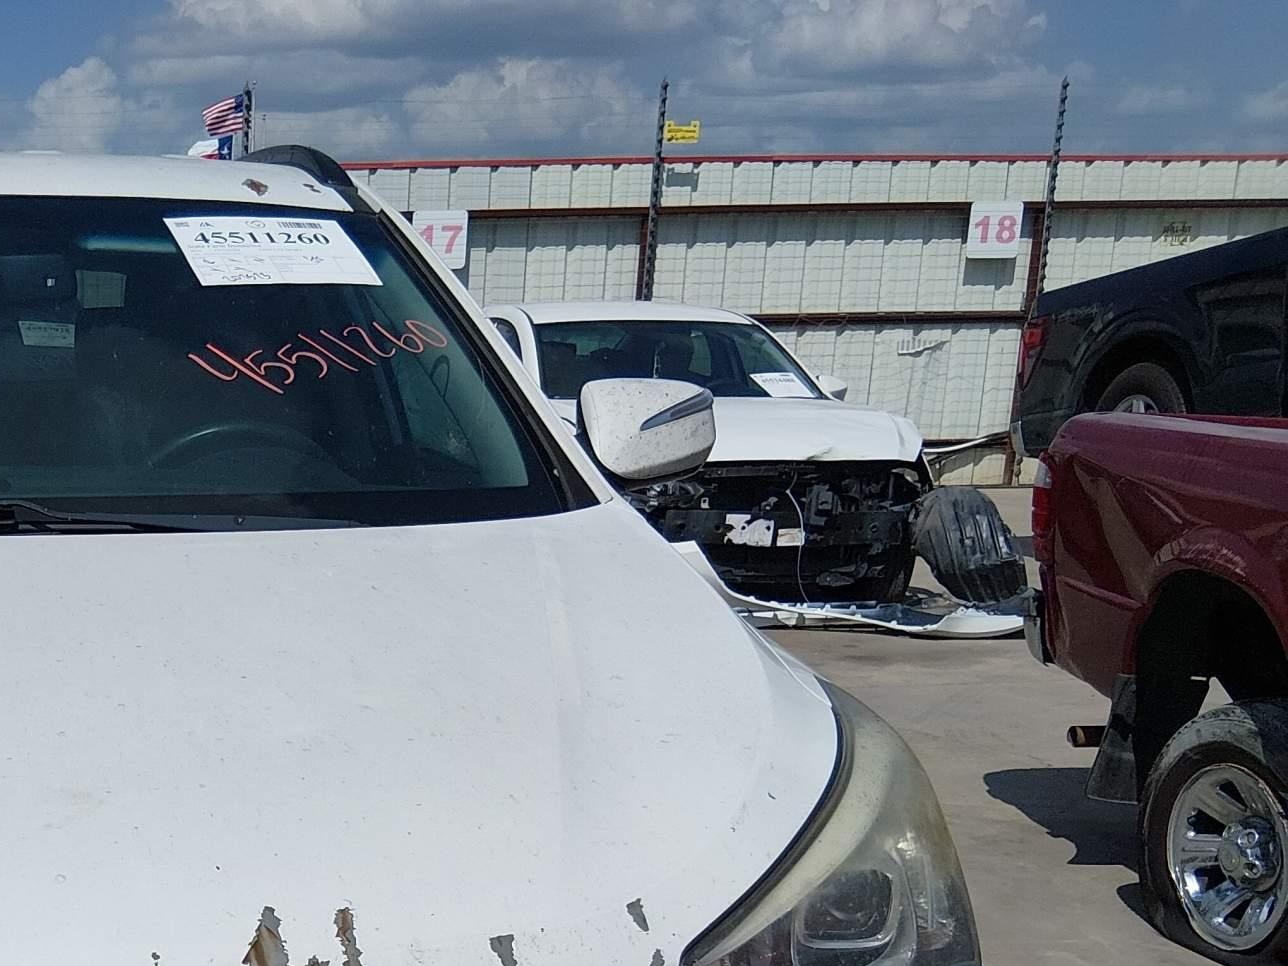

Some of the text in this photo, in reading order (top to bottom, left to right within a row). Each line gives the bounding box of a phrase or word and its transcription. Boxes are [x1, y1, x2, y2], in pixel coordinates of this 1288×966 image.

[194, 231, 330, 245] 45511260
[418, 223, 464, 255] 17
[974, 215, 1017, 244] 18
[187, 319, 448, 395] 45511260
